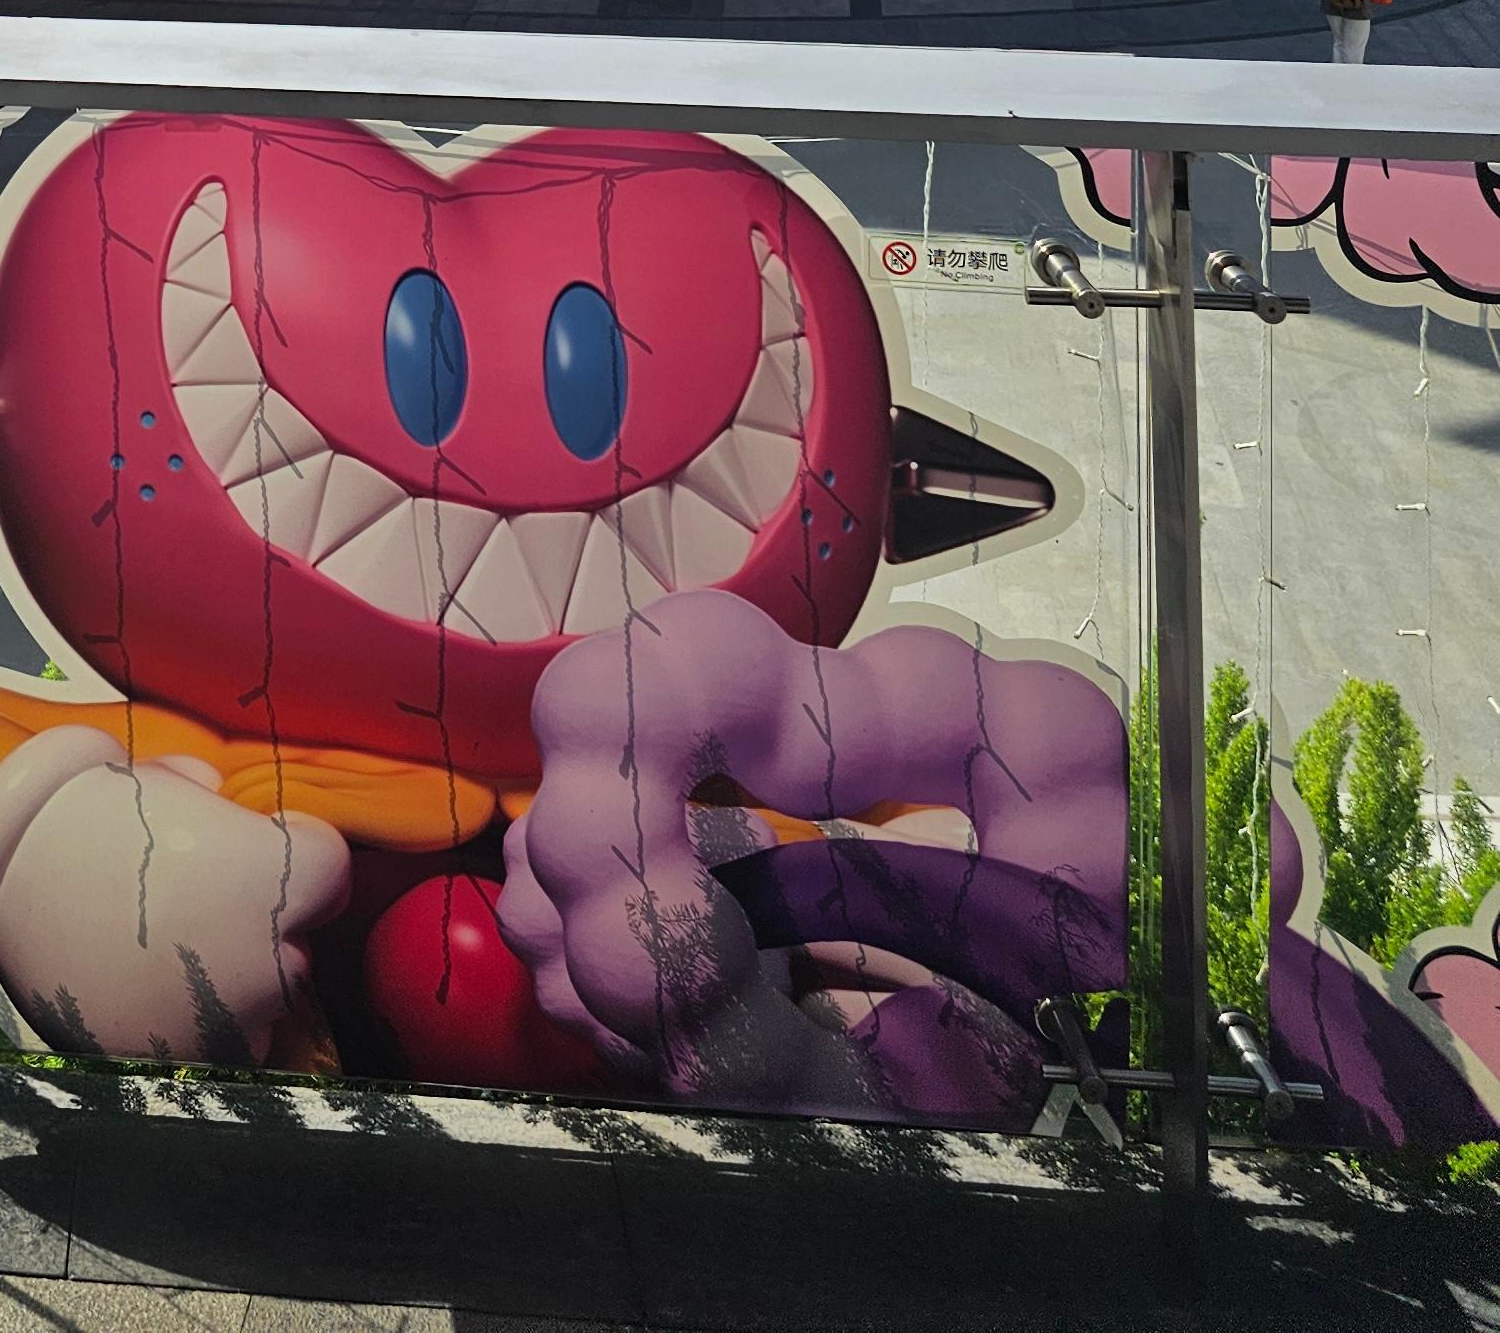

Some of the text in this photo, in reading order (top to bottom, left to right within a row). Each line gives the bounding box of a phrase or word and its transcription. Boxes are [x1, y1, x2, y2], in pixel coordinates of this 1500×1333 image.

[927, 248, 1009, 272] 请勿攀爬
[941, 271, 994, 282] No Climbing
